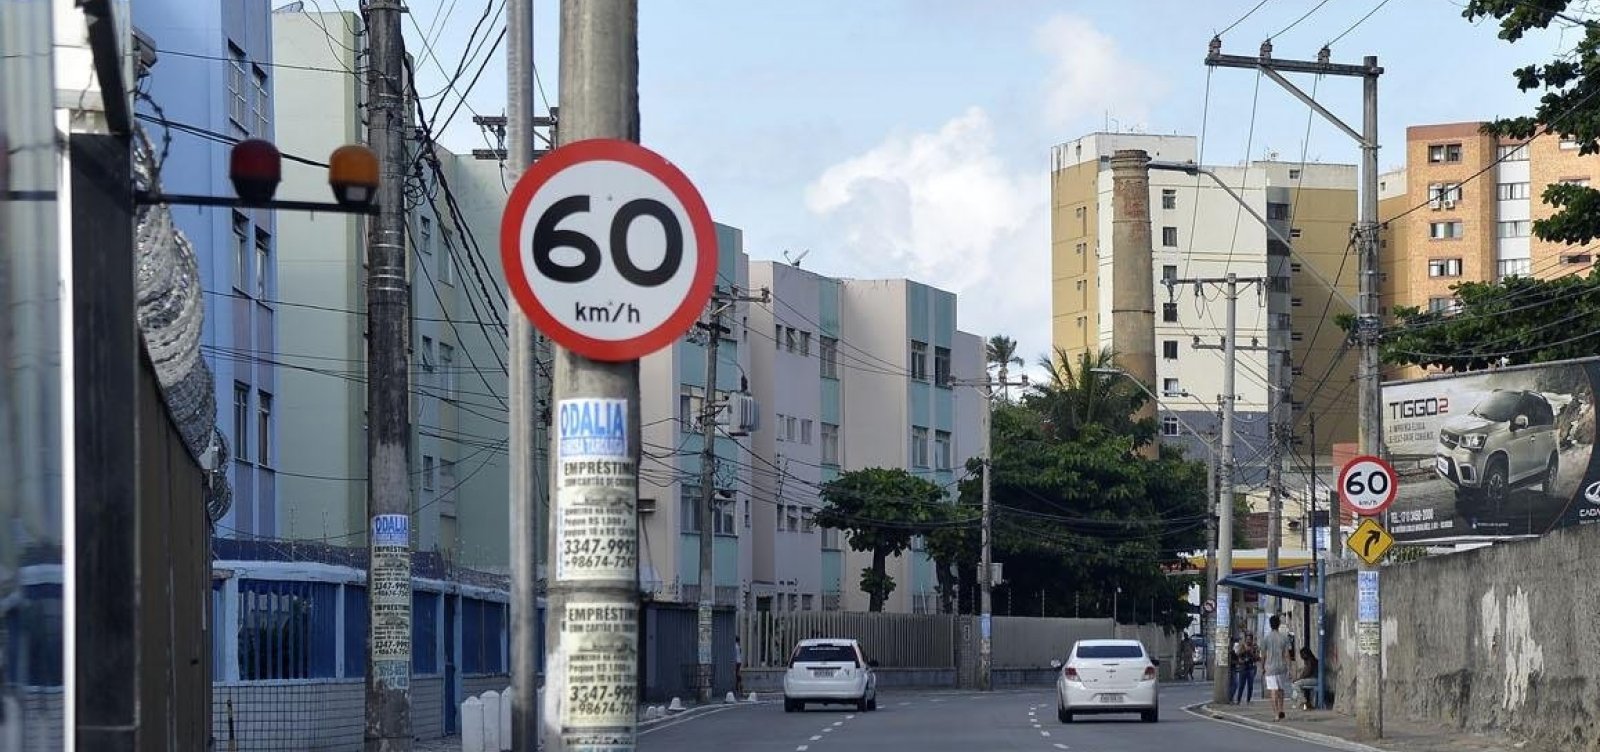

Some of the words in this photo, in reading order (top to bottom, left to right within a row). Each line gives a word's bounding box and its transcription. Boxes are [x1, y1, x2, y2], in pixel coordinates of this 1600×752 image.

[532, 195, 683, 287] 60
[575, 302, 640, 323] km/h
[560, 402, 624, 437] ODALIA
[1346, 471, 1388, 495] 60
